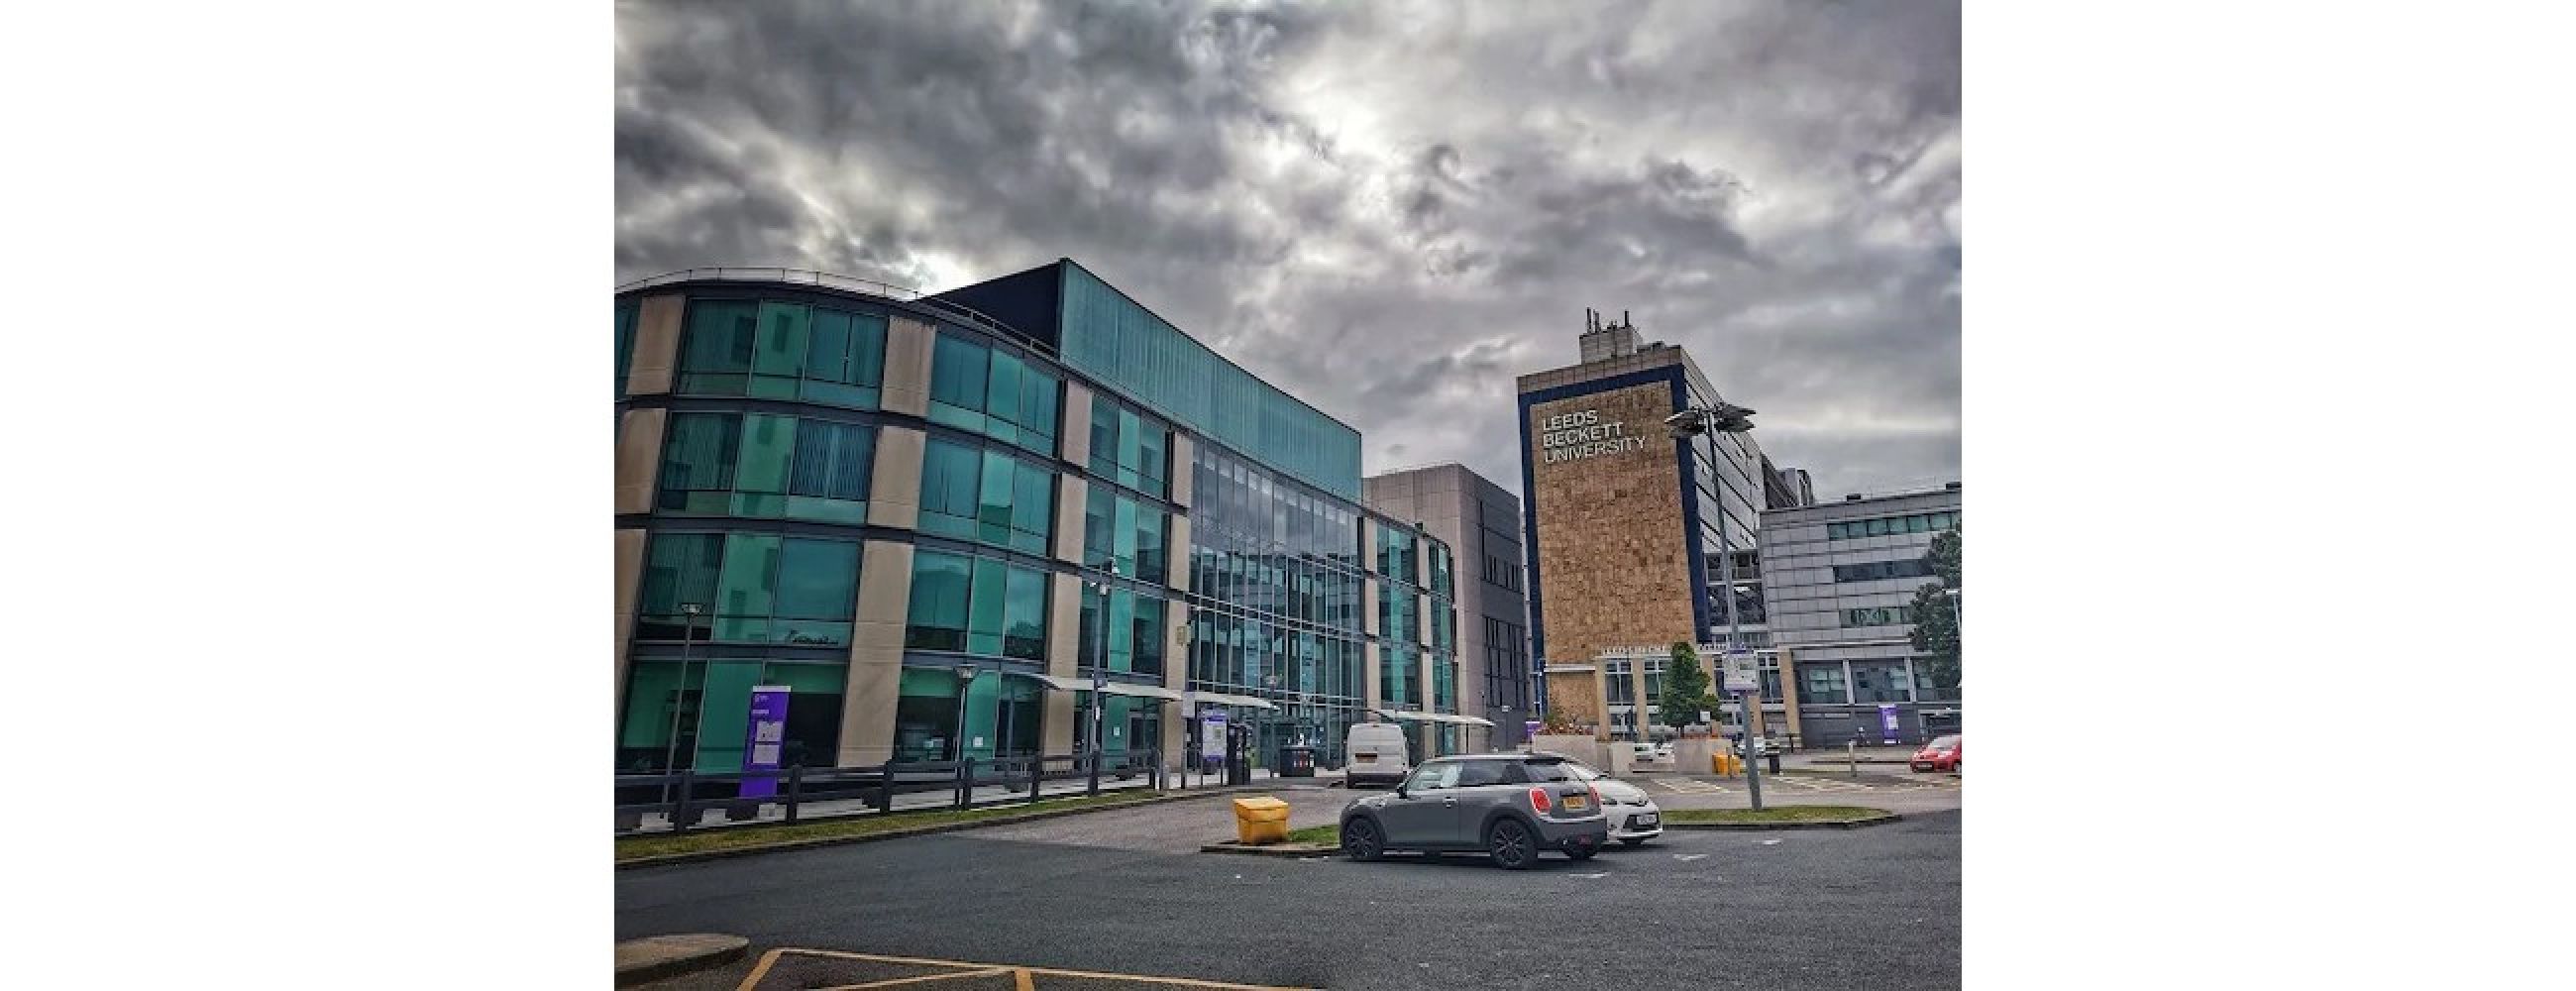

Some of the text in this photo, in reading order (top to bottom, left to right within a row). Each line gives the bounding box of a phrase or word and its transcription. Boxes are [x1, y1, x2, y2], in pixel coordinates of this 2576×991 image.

[1543, 409, 1598, 431] LEEDS
[1543, 421, 1624, 447] BECKETT
[1545, 435, 1646, 463] UNIVERSITY
